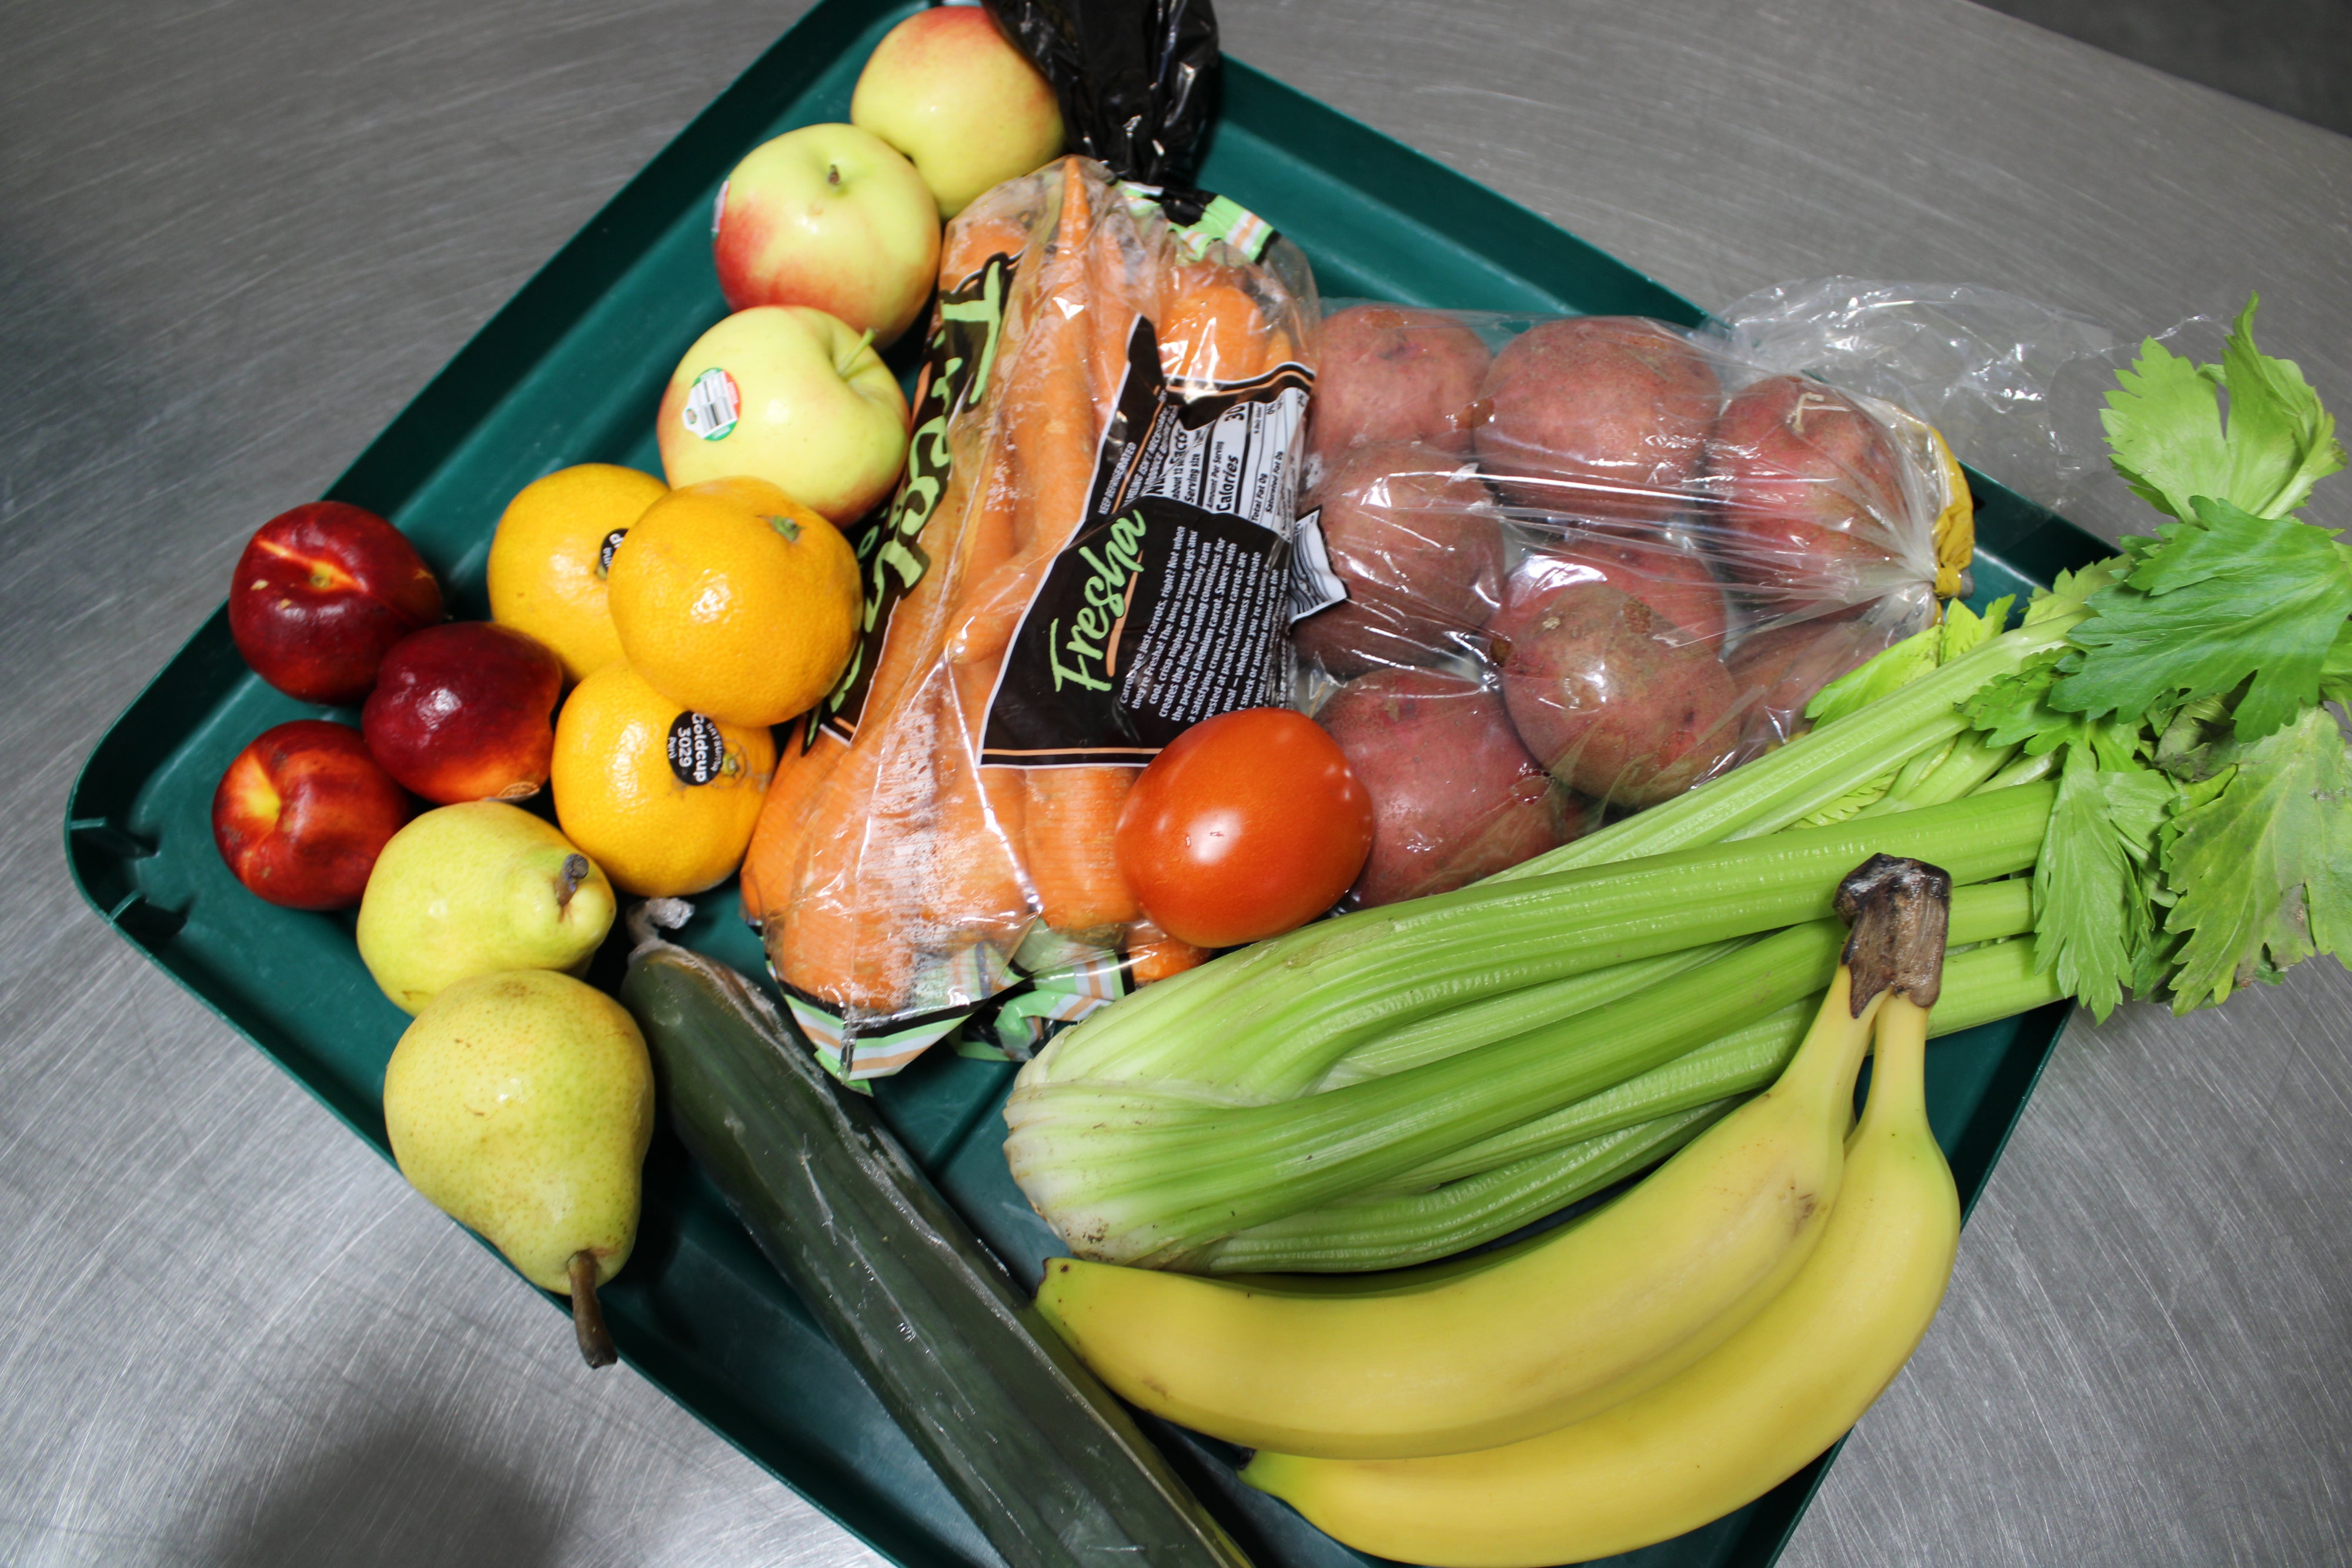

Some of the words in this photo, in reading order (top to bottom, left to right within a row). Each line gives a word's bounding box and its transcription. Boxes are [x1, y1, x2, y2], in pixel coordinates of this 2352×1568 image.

[1225, 404, 1245, 422] 30
[1190, 453, 1200, 467] size
[1213, 442, 1224, 463] Serving
[1098, 496, 1112, 514] KEEP
[1105, 442, 1136, 498] REFRIGERATED
[1211, 465, 1220, 477] Per
[1171, 477, 1182, 499] about
[1184, 469, 1200, 503] Serving
[1207, 479, 1217, 508] Amount
[1217, 455, 1238, 514] Calories
[1251, 500, 1261, 520] Total
[1257, 486, 1265, 499] Fat
[1173, 526, 1185, 550] when
[1188, 531, 1198, 547] and
[1214, 537, 1225, 552] for
[1167, 551, 1179, 568] Not
[1183, 549, 1195, 570] days
[1198, 542, 1211, 564] farm
[1225, 543, 1237, 564] with
[1188, 566, 1206, 595] family
[1201, 554, 1221, 602] conditions
[1215, 566, 1230, 595] Sweet
[1247, 552, 1261, 586] elevate
[1270, 570, 1278, 584] the
[1161, 569, 1175, 597] right?
[1176, 571, 1191, 600] sunny
[1243, 587, 1252, 597] to
[1269, 586, 1277, 598] on
[1050, 509, 1146, 692] Fresha
[1166, 601, 1181, 622] long
[1184, 596, 1194, 613] our
[1209, 597, 1223, 627] carrot.
[1147, 601, 1167, 633] carrots,
[1180, 615, 1190, 627] on
[1190, 603, 1208, 642] growing
[1228, 599, 1250, 650] tenderness
[1261, 600, 1274, 630] dinner
[1137, 634, 1152, 653] just
[1158, 624, 1174, 640] The
[1168, 628, 1186, 657] nights
[1191, 670, 1215, 715] satisfying
[1209, 637, 1227, 669] crunch,
[1219, 603, 1235, 634] Fresha
[1230, 569, 1244, 601] carrots
[1237, 553, 1247, 567] are
[1223, 688, 1237, 711] meal
[1235, 637, 1253, 676] whether
[1248, 606, 1261, 637] you're
[1256, 572, 1268, 604] craving
[1143, 641, 1165, 676] Fresha!
[1177, 643, 1195, 666] ideal
[1193, 628, 1214, 671] premium
[1252, 631, 1268, 666] putting
[1132, 654, 1144, 670] are
[1159, 658, 1173, 681] crisp
[1221, 651, 1235, 675] peak
[1250, 667, 1258, 677] or
[1120, 669, 1137, 703] Carrots
[1171, 667, 1185, 683] the
[1217, 676, 1227, 686] at
[1149, 684, 1165, 704] cool,
[1159, 684, 1178, 717] creates
[1180, 671, 1199, 706] perfect
[1241, 679, 1255, 706] snack
[1254, 682, 1266, 704] your
[1171, 706, 1185, 721] the
[677, 727, 693, 767] 3029
[691, 713, 709, 783] Goldcup
